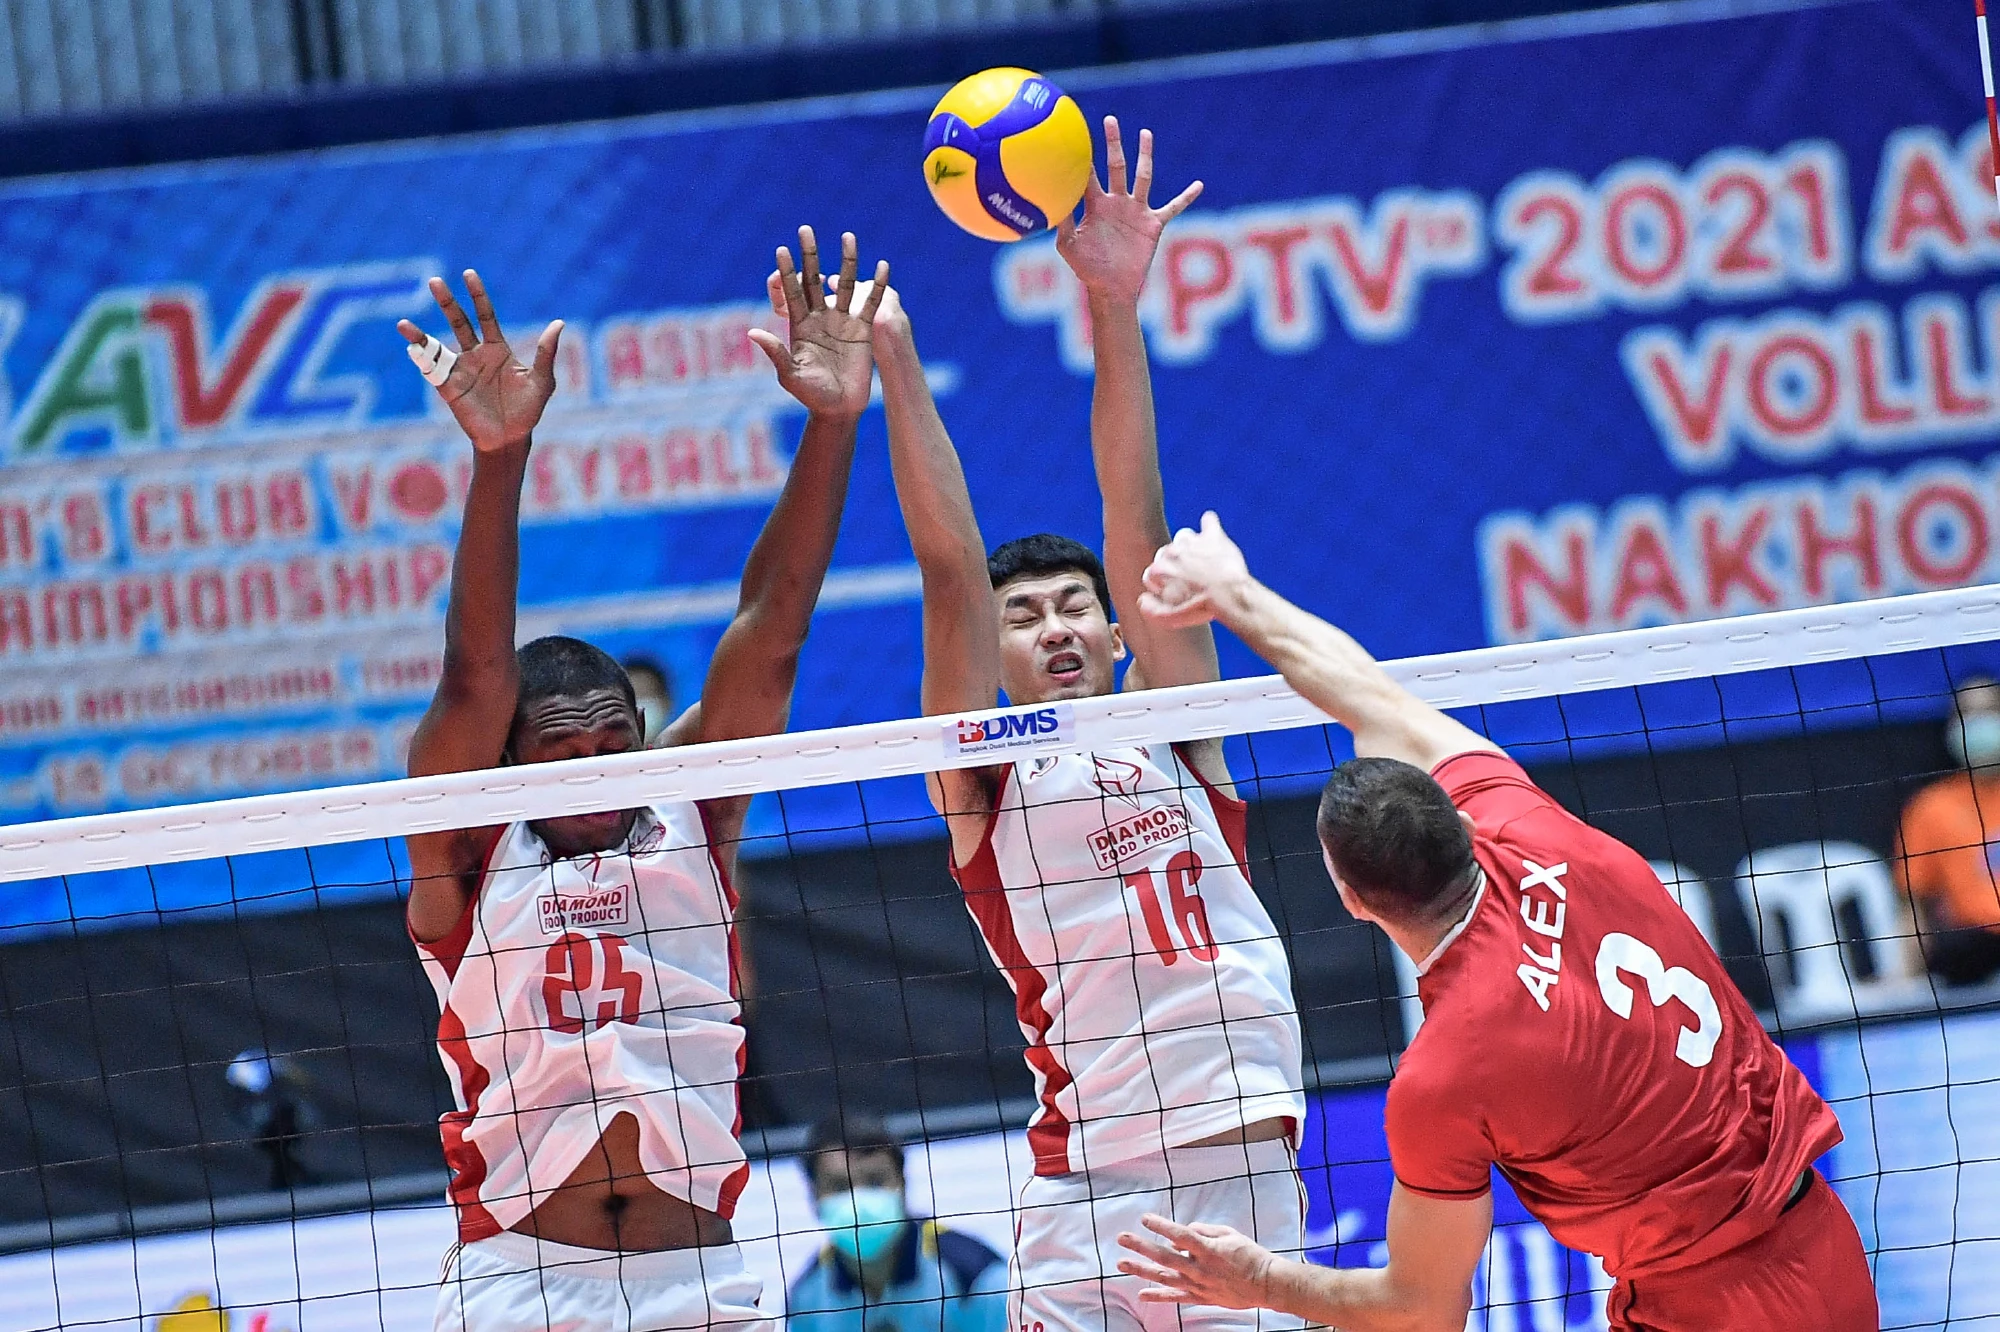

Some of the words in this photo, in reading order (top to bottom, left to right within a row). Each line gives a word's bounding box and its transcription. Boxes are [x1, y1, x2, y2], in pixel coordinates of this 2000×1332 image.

[1510, 155, 1838, 305] 2021
[16, 272, 430, 450] AVC
[130, 470, 309, 550] CLUB
[1500, 480, 1992, 635] NAKHO
[957, 708, 1059, 744] BDMS
[960, 746, 988, 754] Bangkok
[542, 891, 622, 915] DIAMOND
[1101, 841, 1137, 864] FOOD
[545, 914, 567, 929] FOOD
[571, 907, 622, 925] PRODUCT
[1125, 851, 1219, 967] 16
[1516, 859, 1568, 1012] ALEX
[542, 932, 642, 1034] 25
[1594, 932, 1723, 1067] 3
